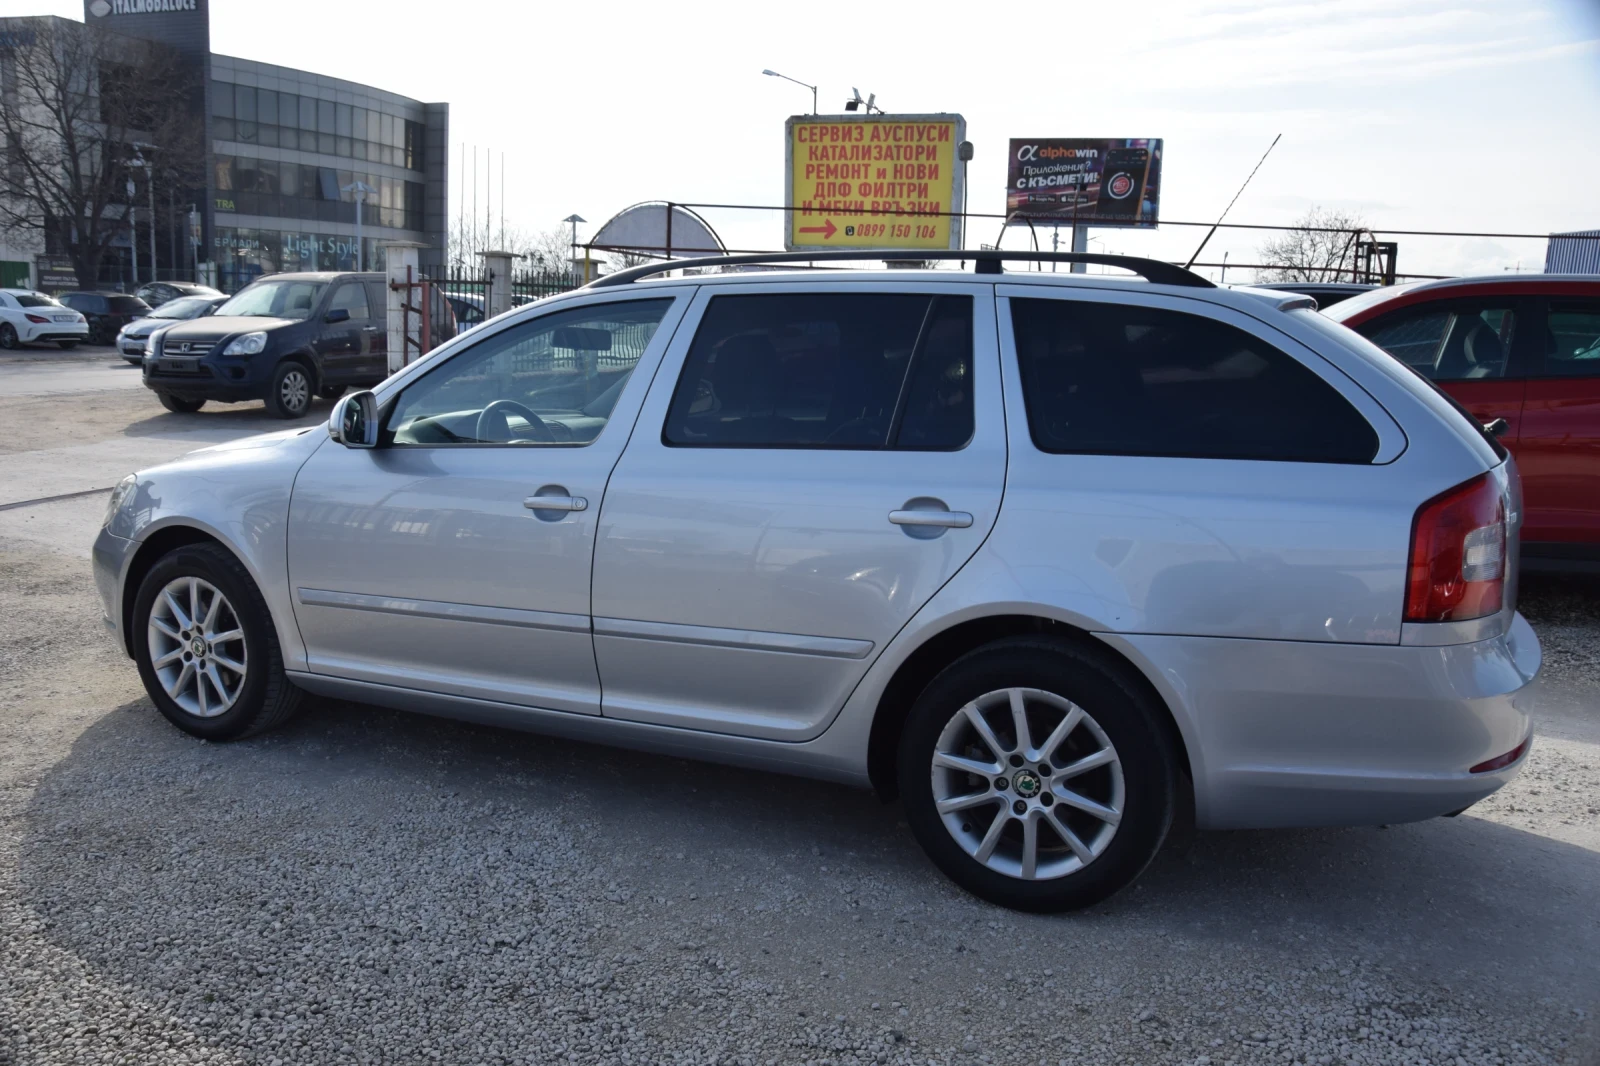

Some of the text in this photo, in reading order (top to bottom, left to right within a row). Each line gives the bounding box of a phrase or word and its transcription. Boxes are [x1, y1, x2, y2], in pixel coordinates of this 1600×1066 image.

[113, 0, 196, 14] ITALMODALUCE
[798, 125, 950, 143] СЕРВИЗ АУСПУСИ
[809, 145, 937, 161] КАТАЛИЗАТОРИ
[1039, 146, 1098, 160] alphawin
[806, 163, 871, 180] РЕМОНТ
[893, 163, 940, 180] НОВИ
[1023, 161, 1091, 176] Приложение?
[1028, 172, 1098, 188] КЪСМЕТИ!
[813, 181, 929, 200] ДПФ ФИЛТРИ
[802, 200, 940, 218] И МЕКИ ВРЪЗКИ
[857, 224, 937, 239] 0899 150 106
[287, 234, 325, 259] Light
[327, 236, 359, 260] Style
